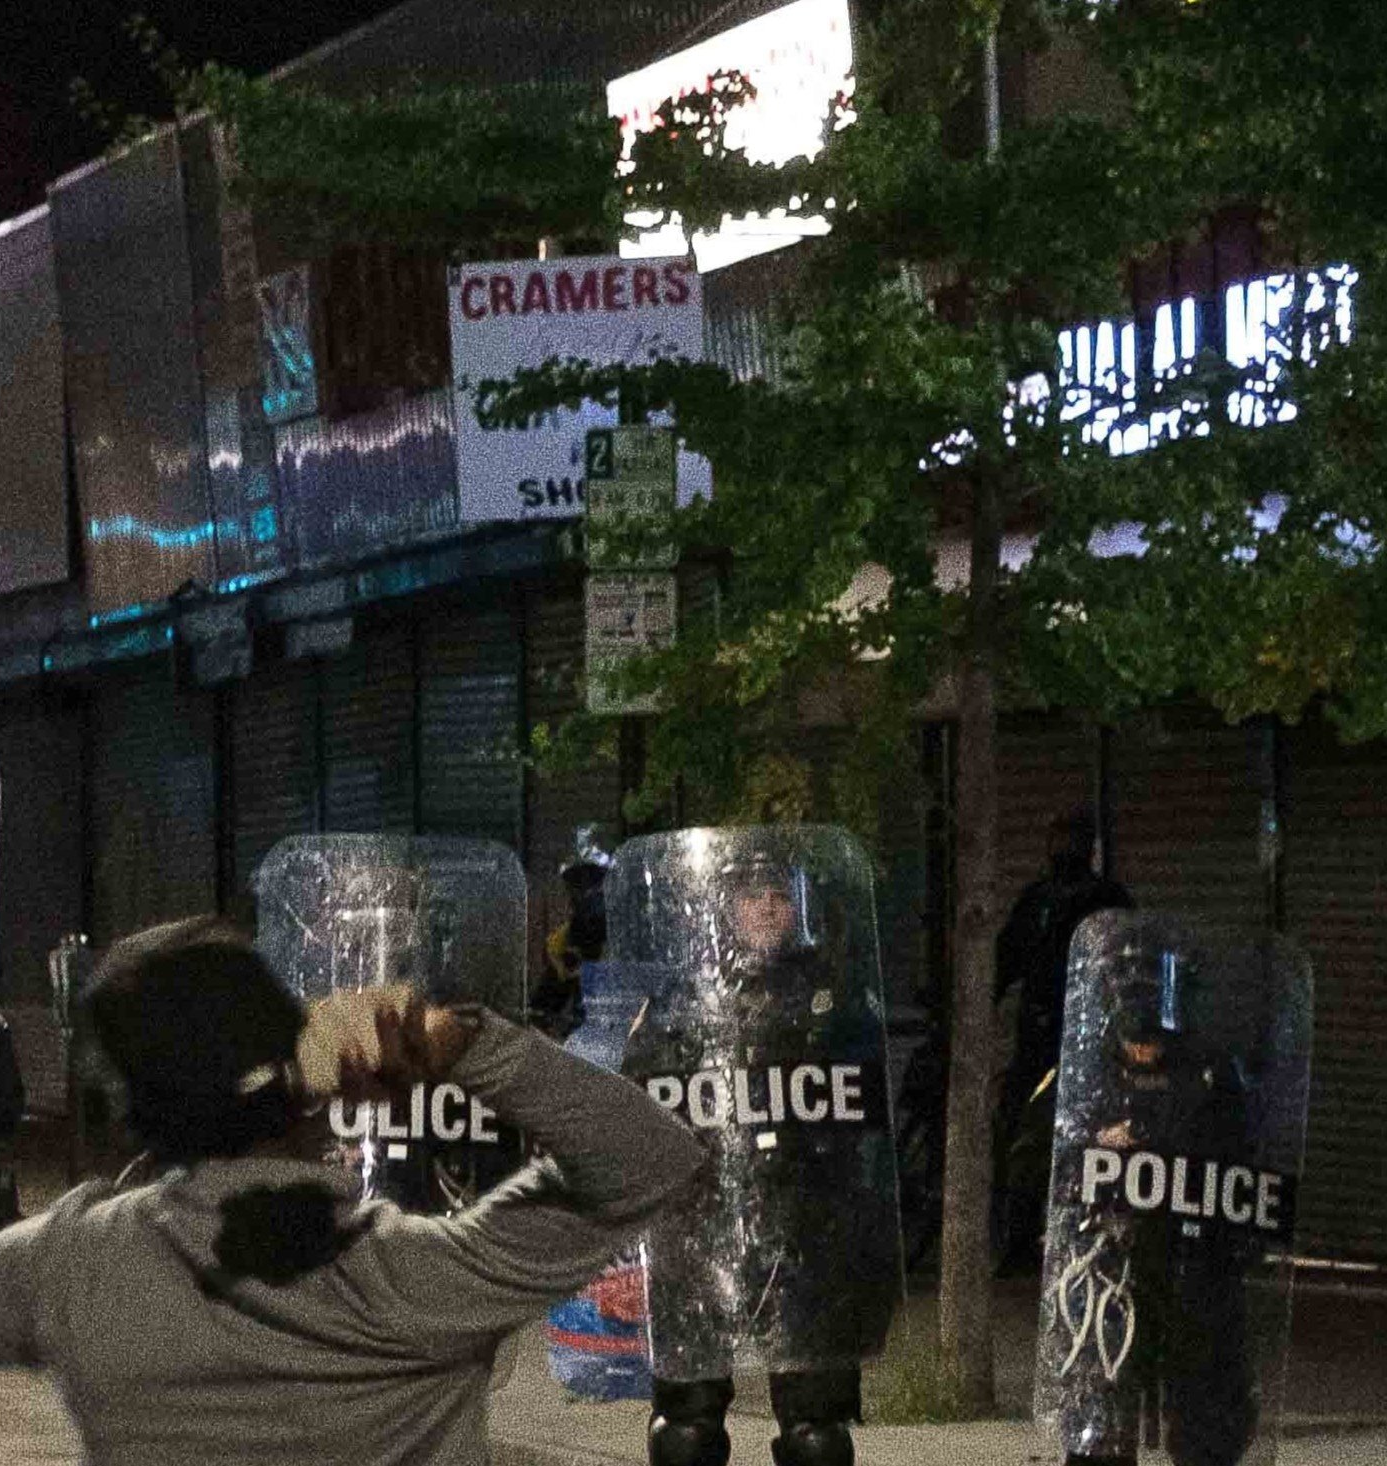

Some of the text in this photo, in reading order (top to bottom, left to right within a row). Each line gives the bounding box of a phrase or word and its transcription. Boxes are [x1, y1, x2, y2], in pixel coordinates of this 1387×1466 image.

[461, 262, 692, 321] CRAMERS
[591, 437, 608, 472] 2
[329, 1082, 499, 1143] OLICE
[648, 1064, 865, 1128] POLICE
[1081, 1147, 1283, 1230] POLICE
